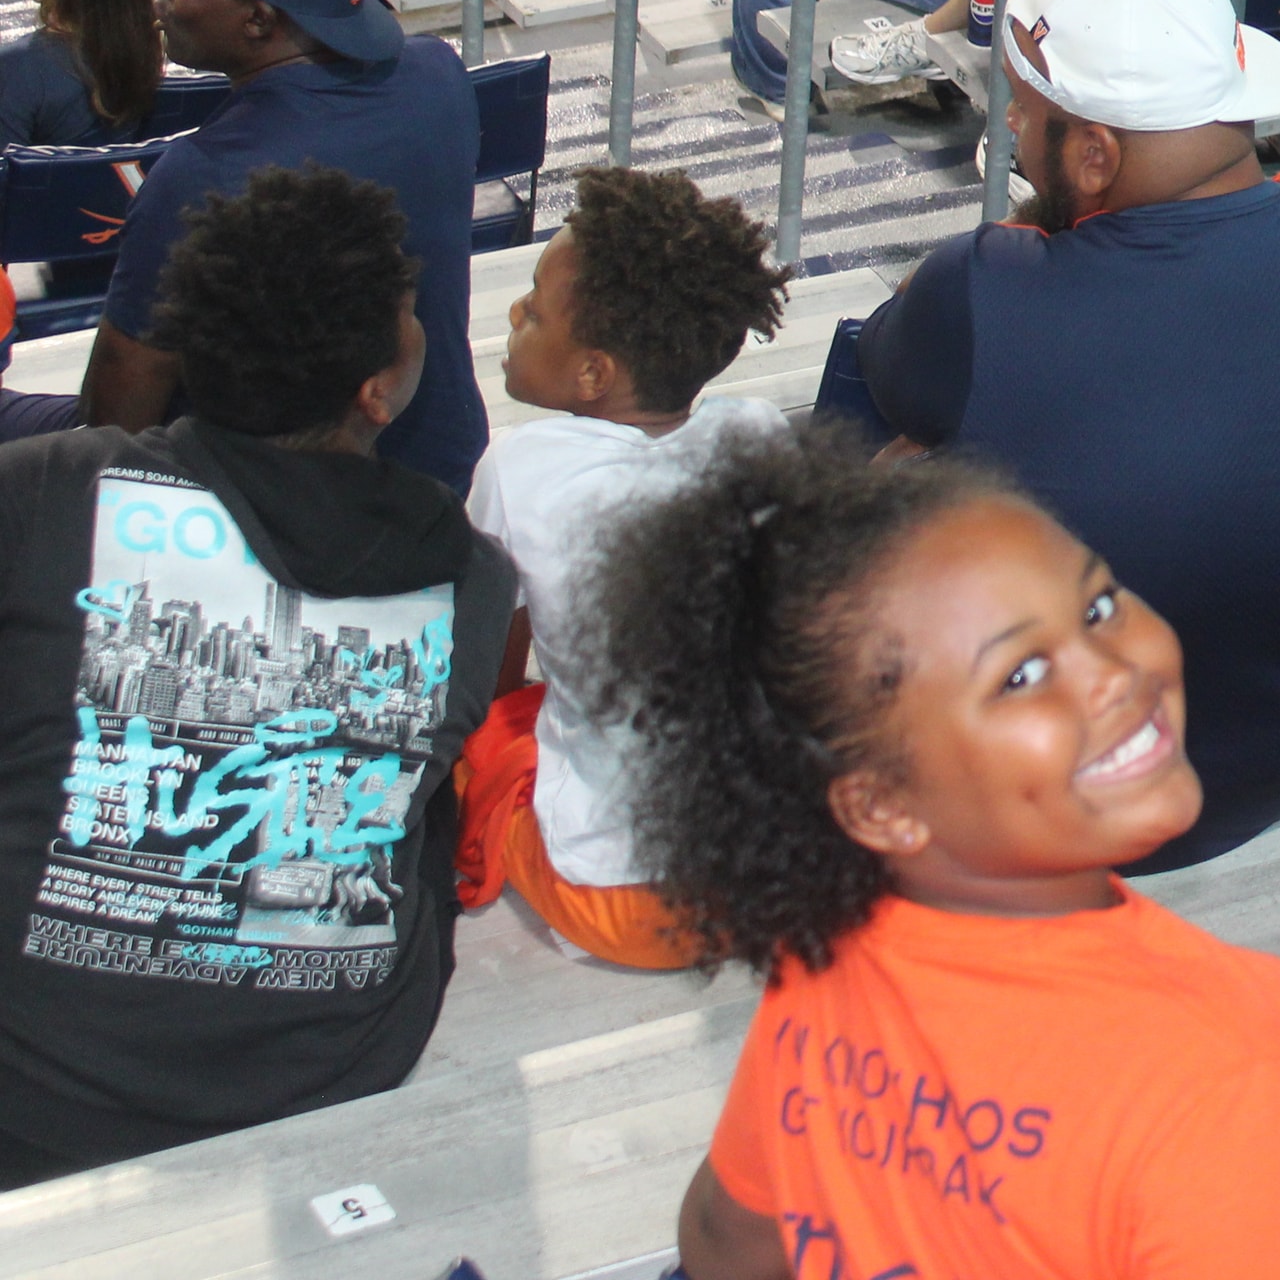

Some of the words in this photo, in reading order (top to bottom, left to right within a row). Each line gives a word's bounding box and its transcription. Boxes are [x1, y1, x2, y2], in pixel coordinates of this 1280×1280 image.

[73, 740, 203, 771] MANHATTAN
[69, 776, 150, 802] QUEENS
[72, 758, 185, 789] BROOKLYN
[62, 813, 131, 845] BRONX
[147, 809, 220, 829] ISLAND
[42, 878, 52, 888] A
[54, 881, 96, 898] STORY
[98, 891, 125, 904] AND
[127, 895, 170, 910] EVERY
[170, 901, 223, 917] SKYLINE
[47, 863, 91, 882] WHERE
[93, 872, 135, 892] EVERY
[136, 883, 183, 899] STREET
[185, 889, 223, 903] TELLS
[38, 890, 96, 913] INSPIRES
[98, 905, 107, 915] A
[31, 913, 153, 955] WHERE
[25, 933, 249, 985] ADVENTURE
[256, 968, 336, 990] NEW
[342, 1198, 367, 1220] 5
